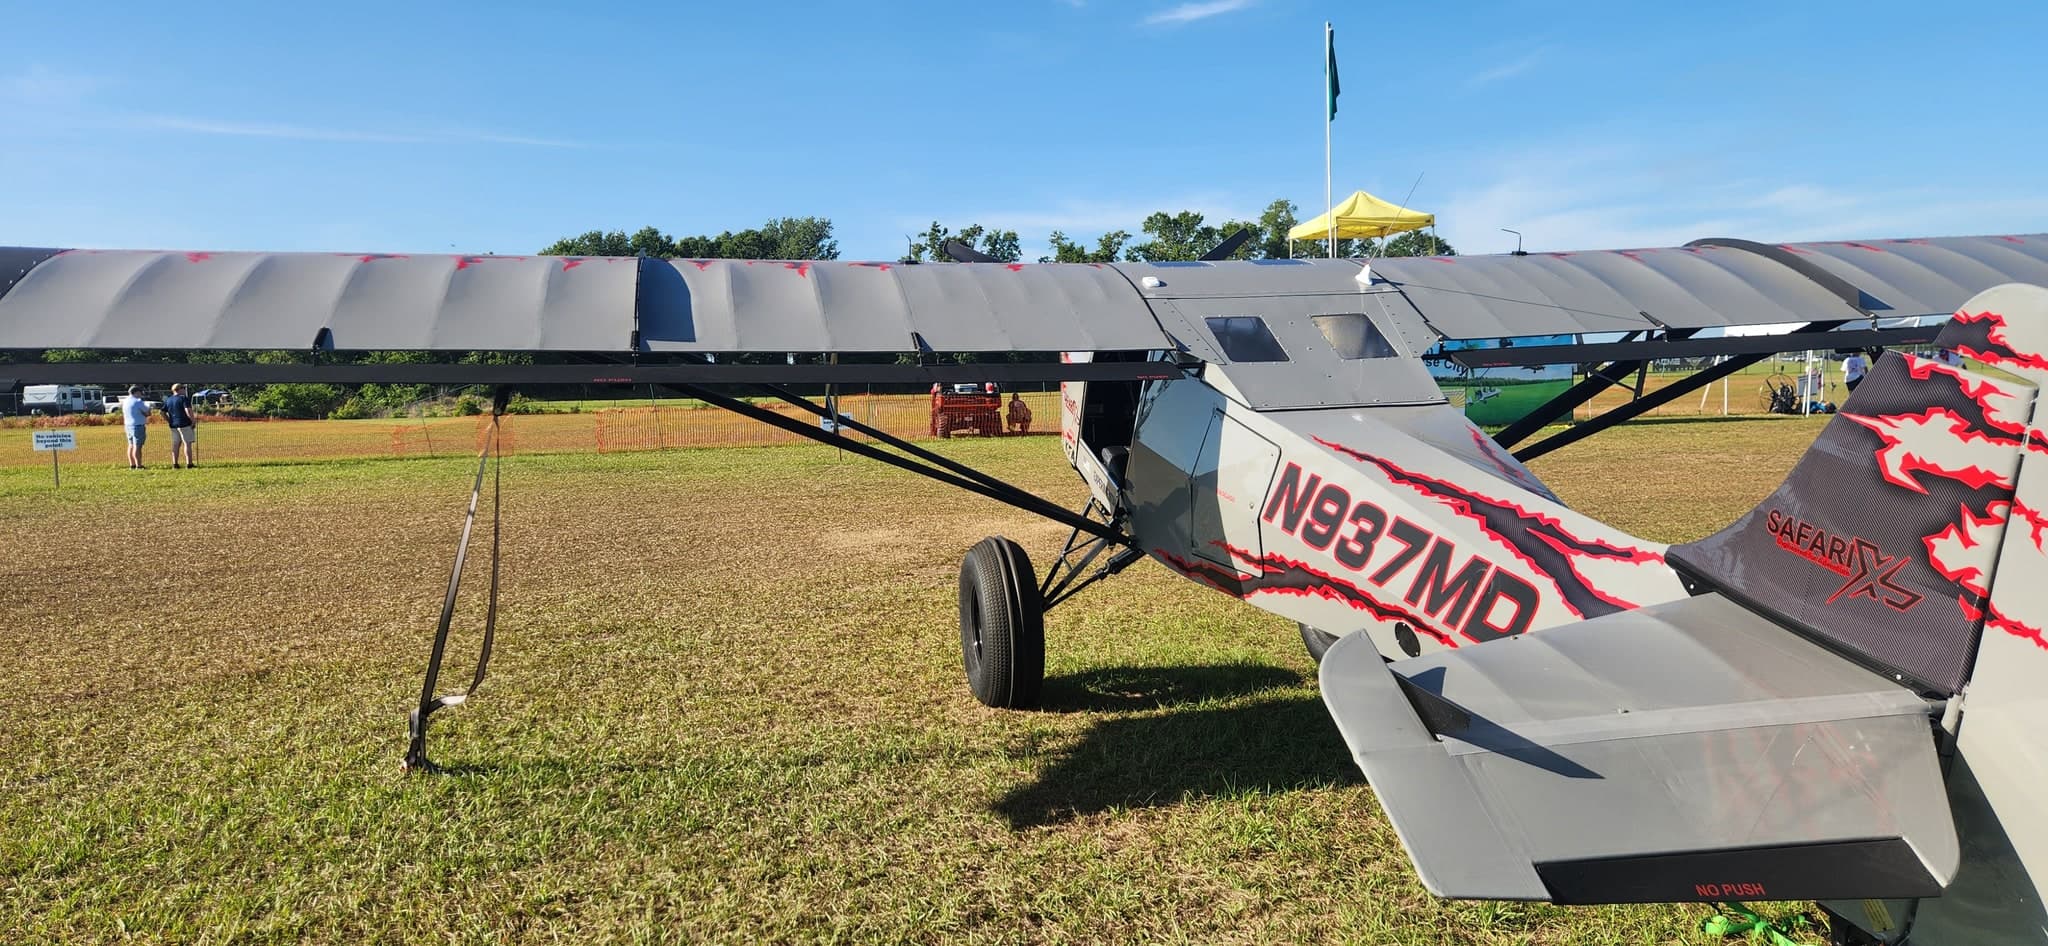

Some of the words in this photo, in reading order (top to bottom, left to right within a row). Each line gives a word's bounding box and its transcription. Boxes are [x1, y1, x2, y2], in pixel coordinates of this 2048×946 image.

[1263, 461, 1541, 643] N937MD
[1767, 508, 1856, 569] SAFARI
[1695, 884, 1720, 897] NO
[1721, 883, 1767, 897] PUSH
